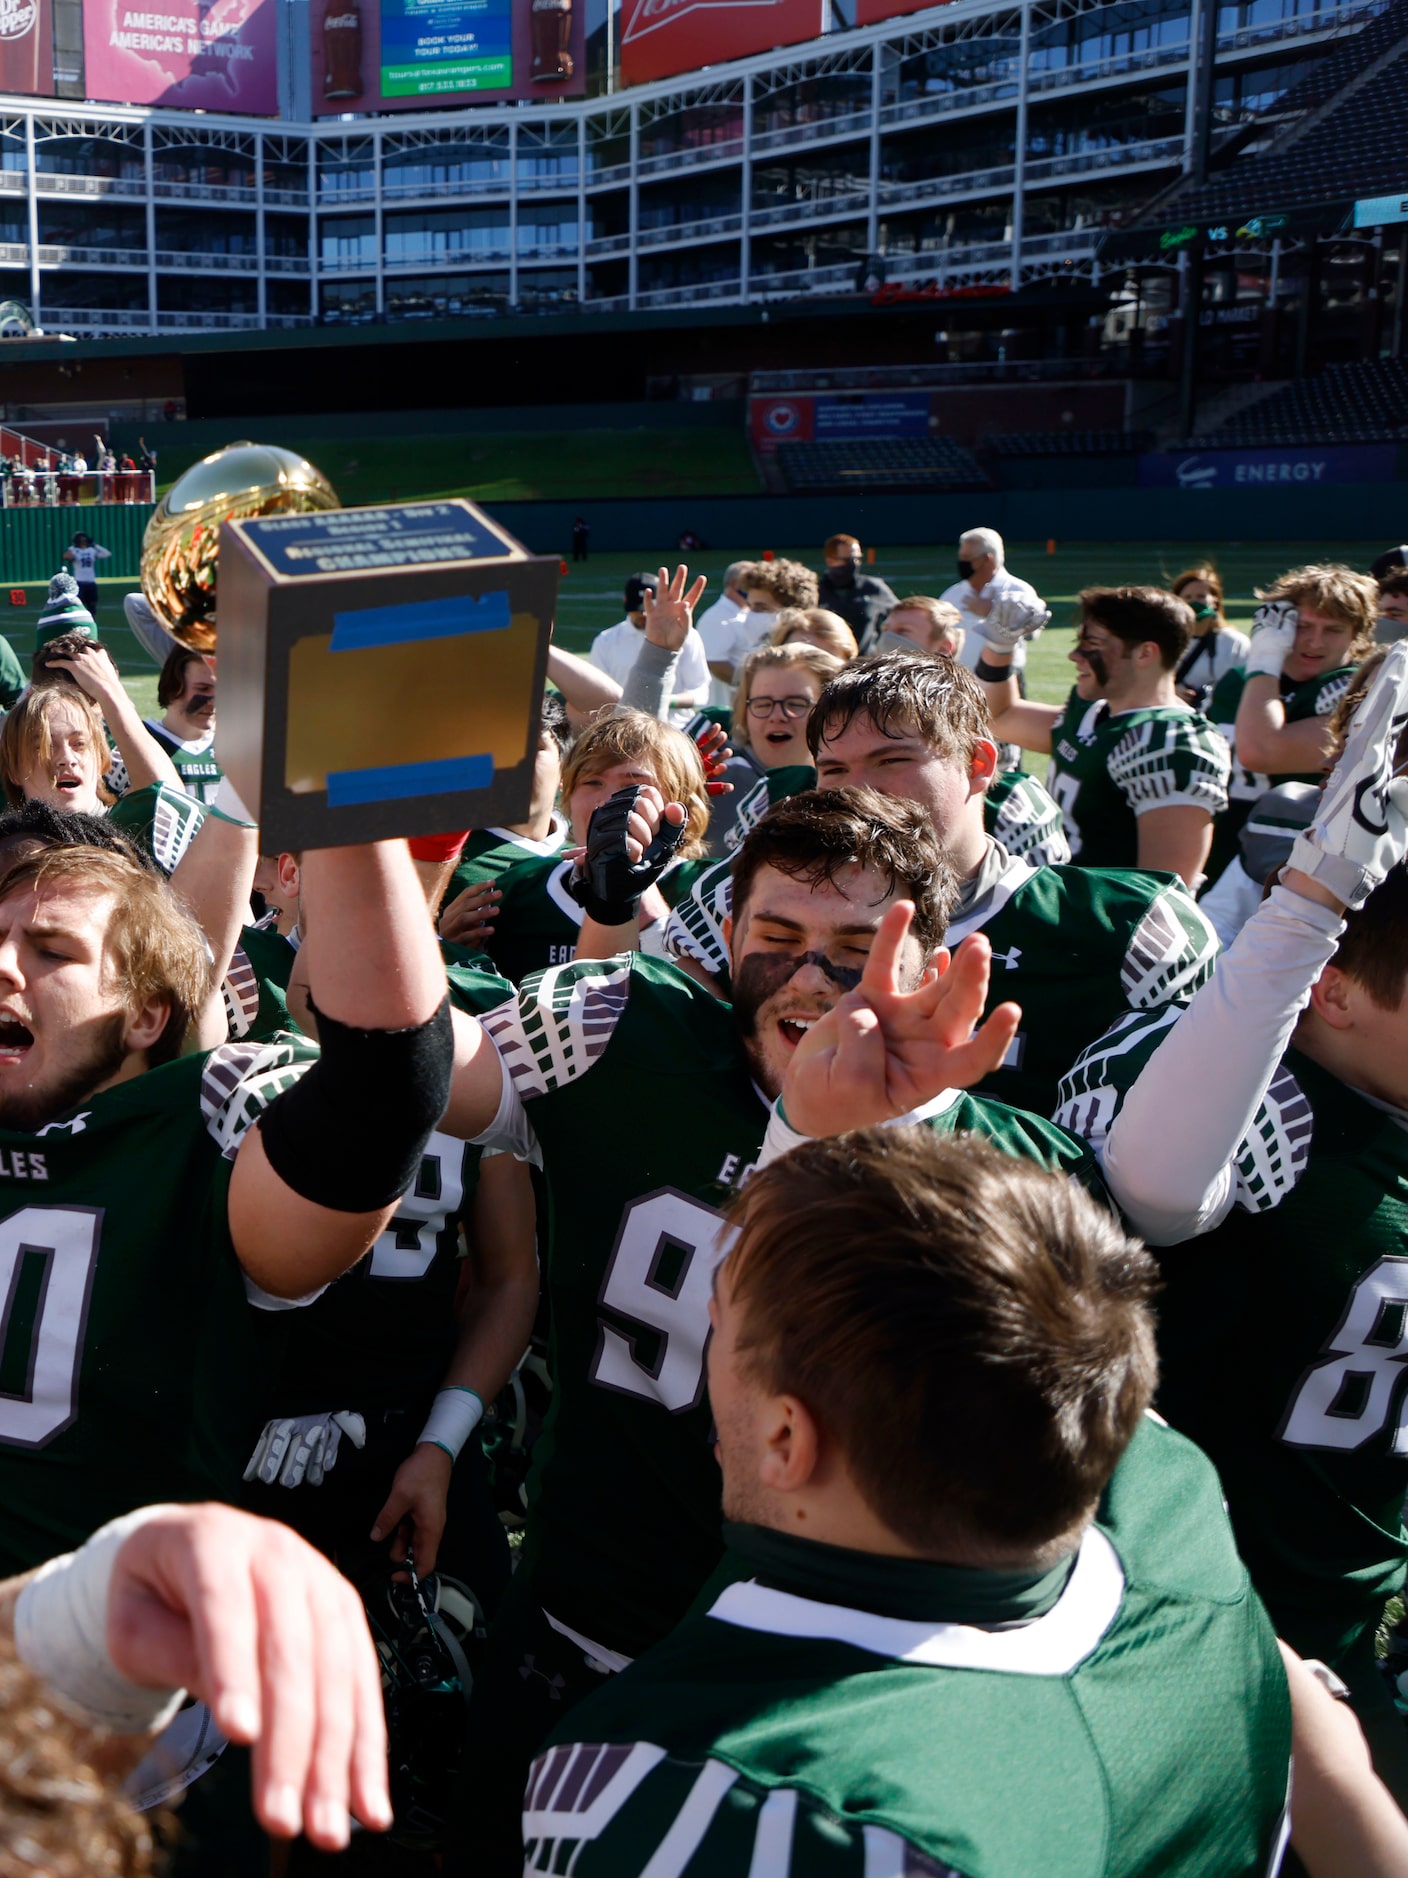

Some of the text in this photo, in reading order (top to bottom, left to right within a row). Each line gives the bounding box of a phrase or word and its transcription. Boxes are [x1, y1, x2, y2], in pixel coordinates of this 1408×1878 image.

[123, 11, 197, 35] AMERICA'S
[109, 30, 184, 53] AMERICA'S
[417, 33, 475, 46] BOOK YOUR
[414, 46, 440, 56] TOUR
[1235, 462, 1325, 482] ENERGY
[435, 505, 451, 515] 2
[316, 545, 472, 571] CHAMPIONS
[181, 763, 218, 776] EAGLES
